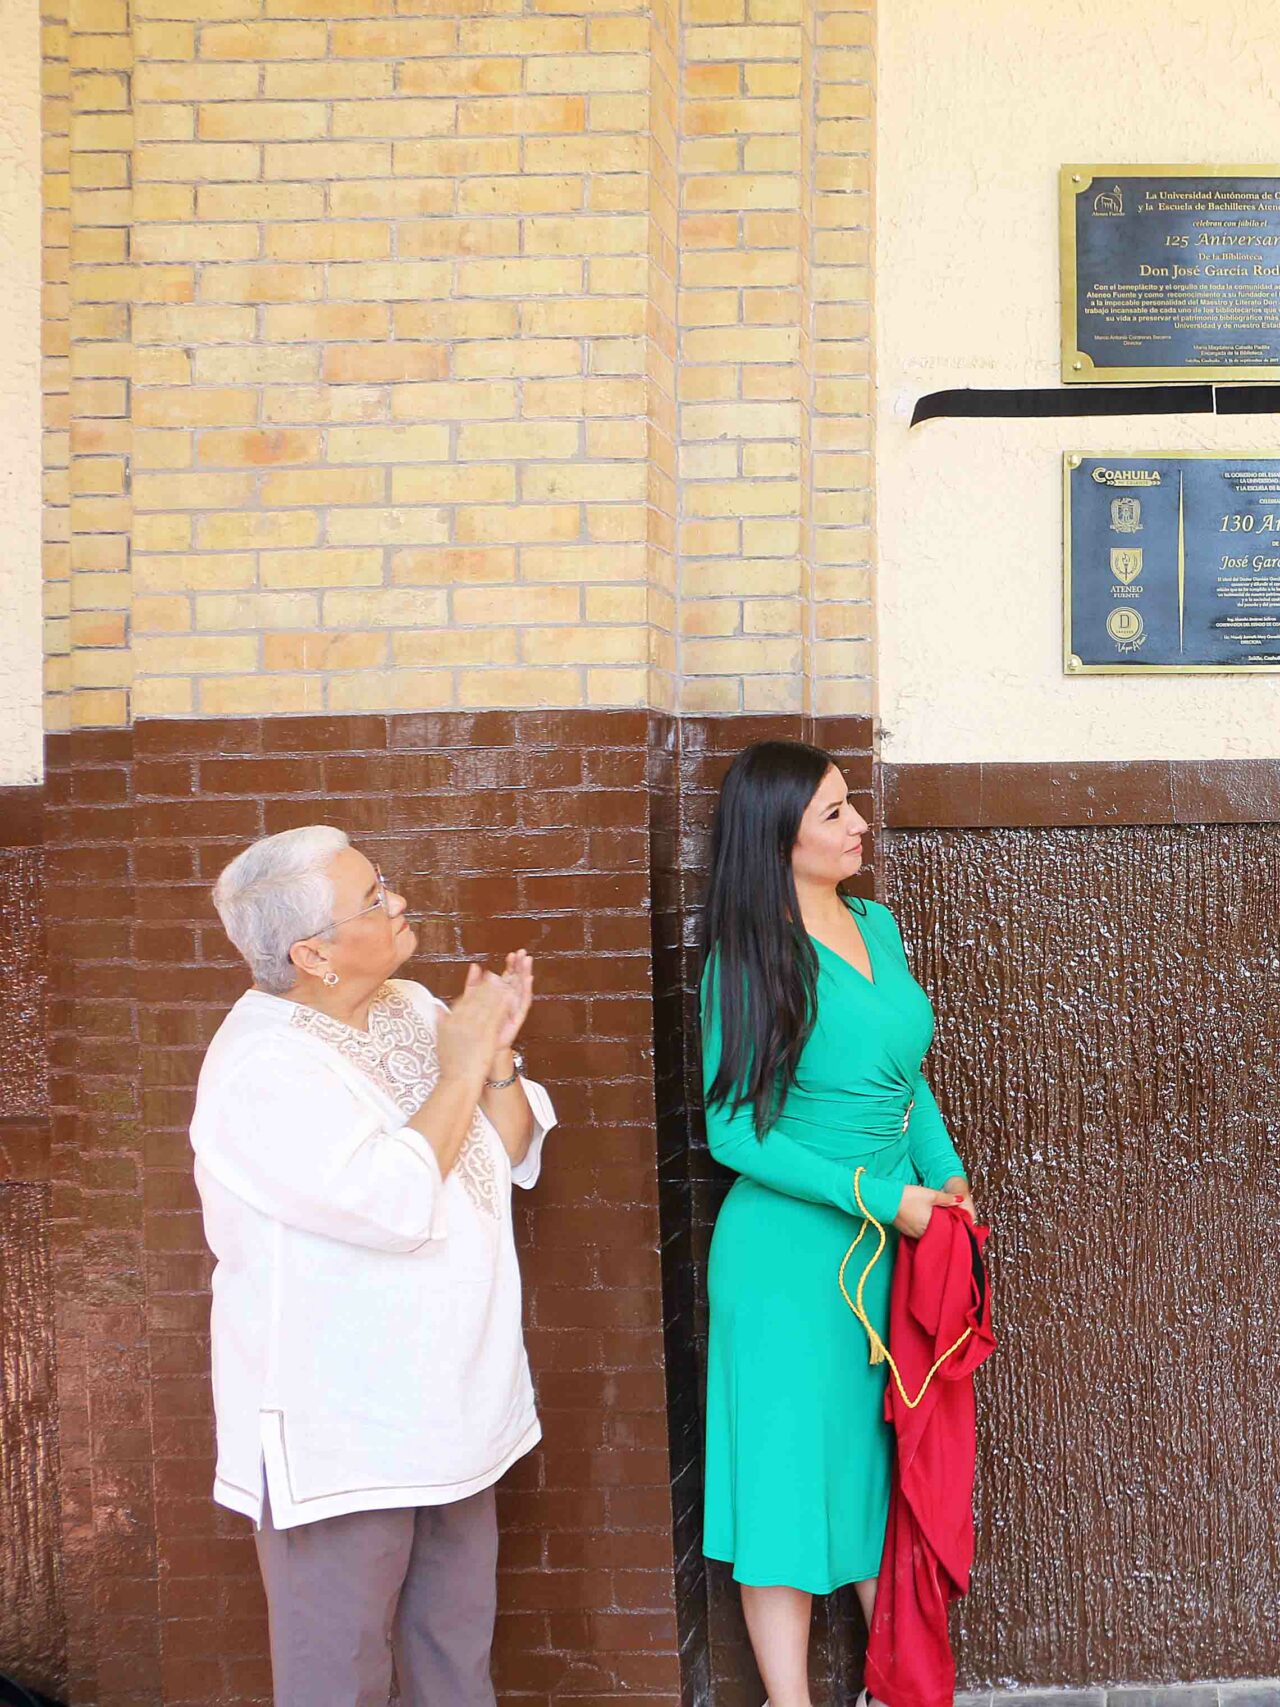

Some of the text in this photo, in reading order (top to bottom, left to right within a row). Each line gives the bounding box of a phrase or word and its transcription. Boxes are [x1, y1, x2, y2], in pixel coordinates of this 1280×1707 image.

[1146, 192, 1157, 200] La
[1160, 192, 1212, 200] Universidad
[1214, 192, 1259, 200] Autónoma
[1262, 192, 1272, 200] de
[1158, 203, 1193, 211] Escuela
[1195, 203, 1206, 211] de
[1208, 203, 1256, 211] Bachilleres
[1238, 220, 1259, 229] júbilo
[1166, 235, 1190, 248] 125
[1140, 265, 1169, 276] Don
[1172, 265, 1201, 279] José
[1205, 265, 1248, 276] García
[1092, 467, 1161, 482] COAHUILA
[1220, 515, 1254, 532] 130
[1219, 555, 1248, 570] José
[1120, 614, 1131, 629] D
